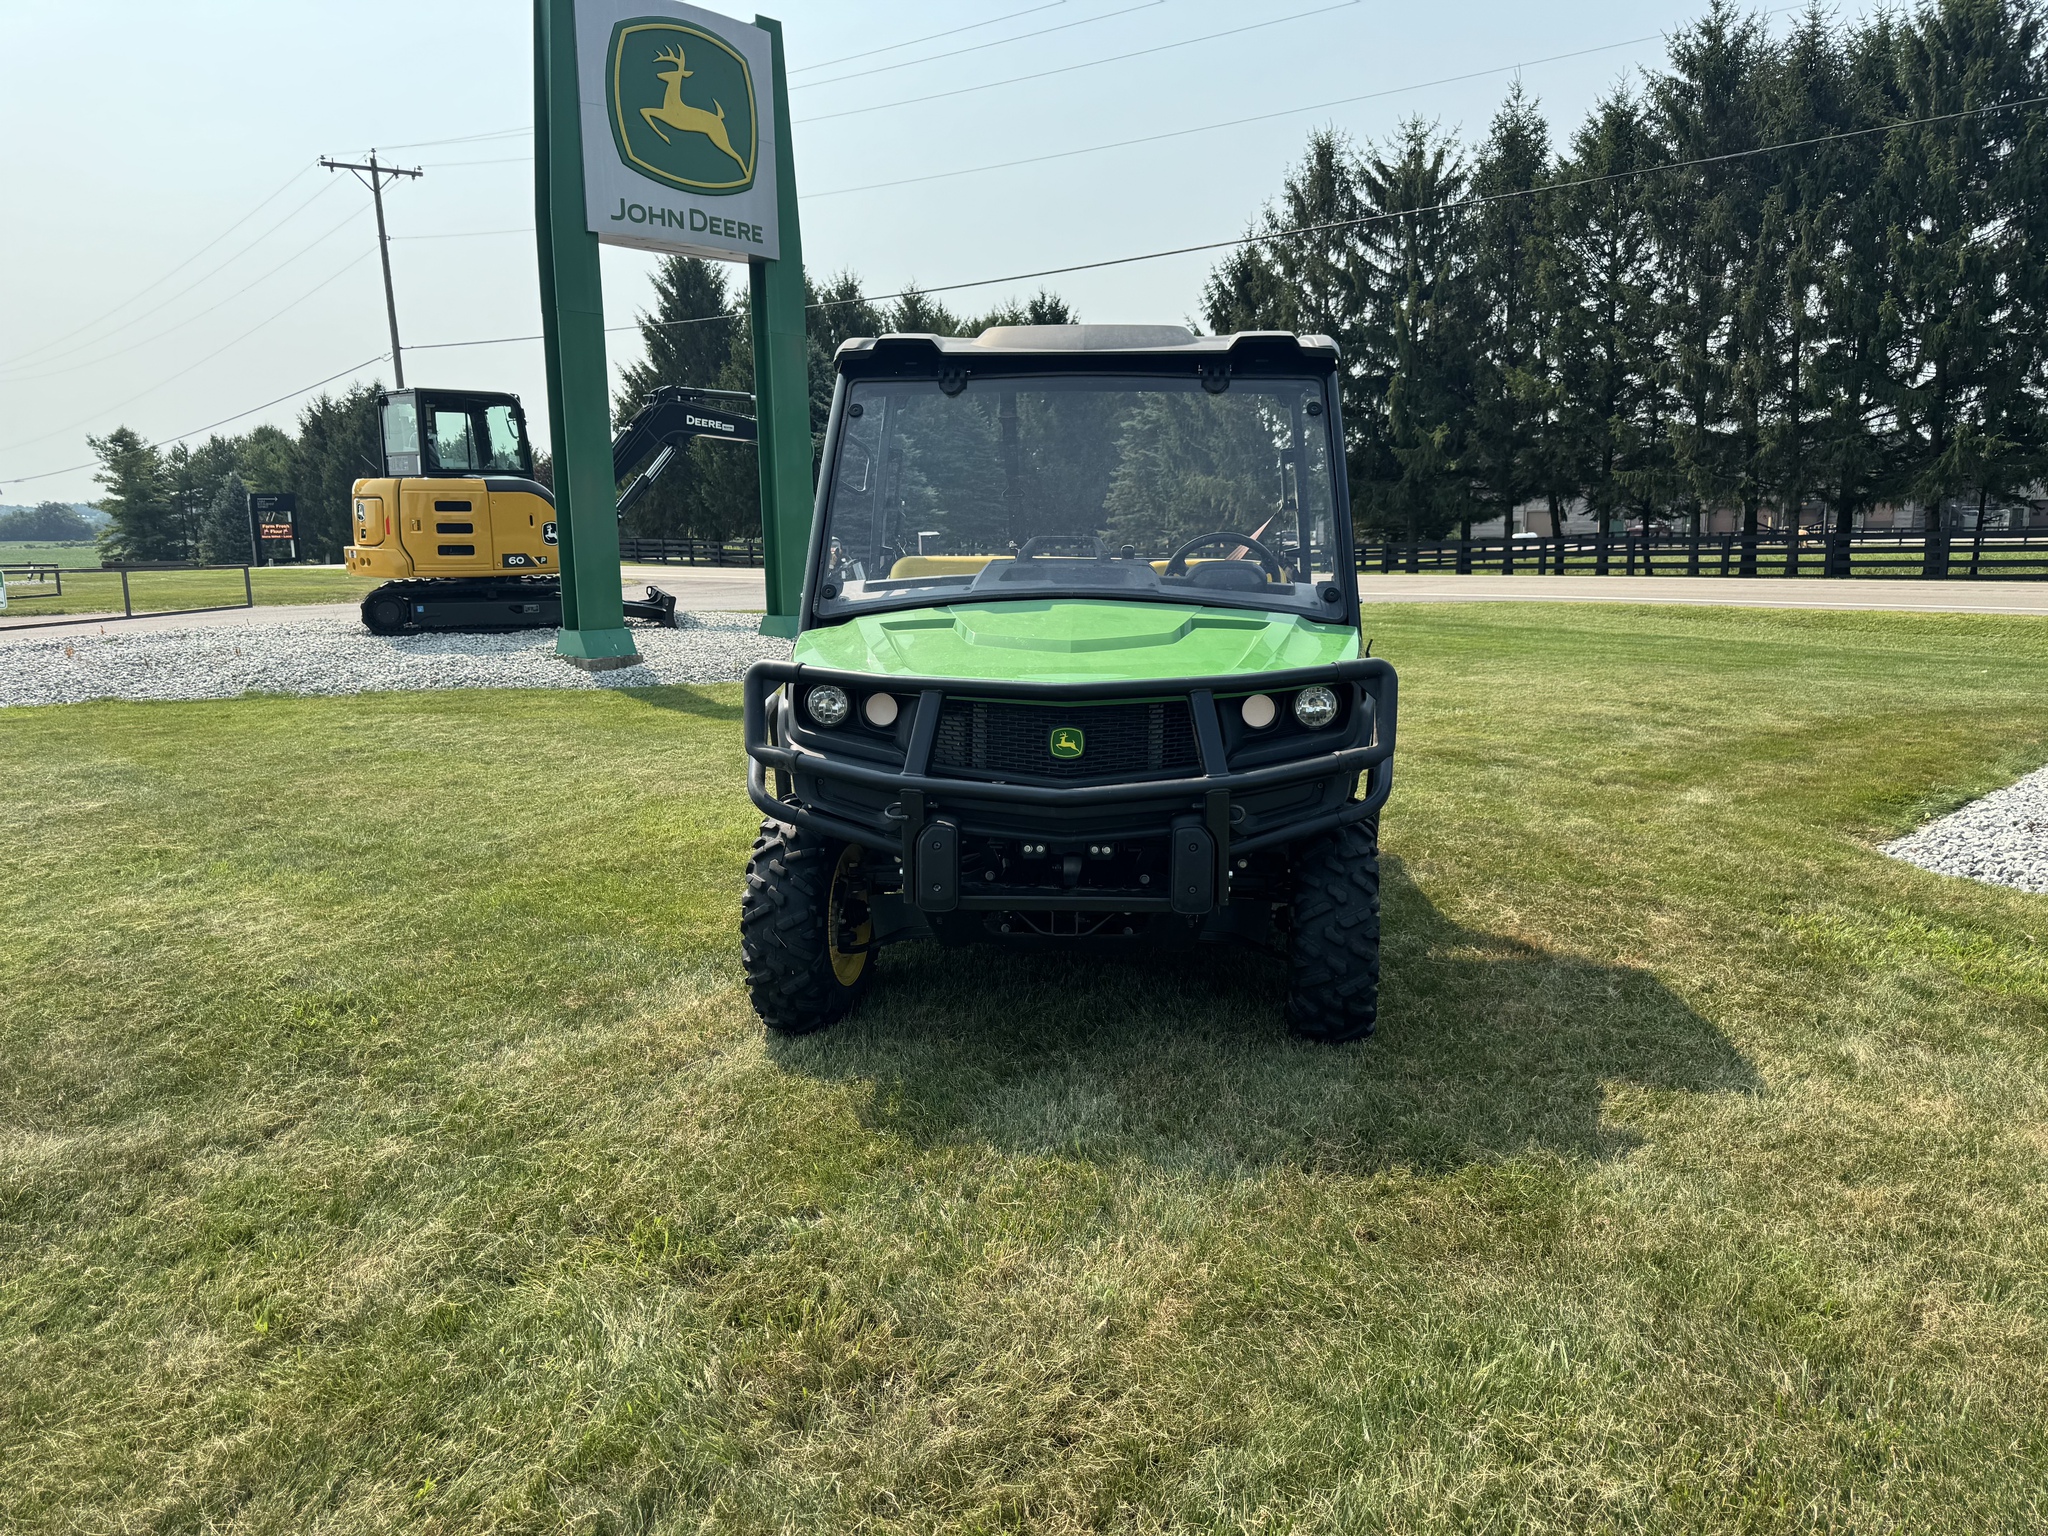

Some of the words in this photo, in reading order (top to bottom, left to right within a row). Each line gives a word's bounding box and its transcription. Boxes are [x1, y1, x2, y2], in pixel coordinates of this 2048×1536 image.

[686, 414, 722, 429] DEERE
[508, 556, 525, 565] 60
[540, 556, 547, 564] P
